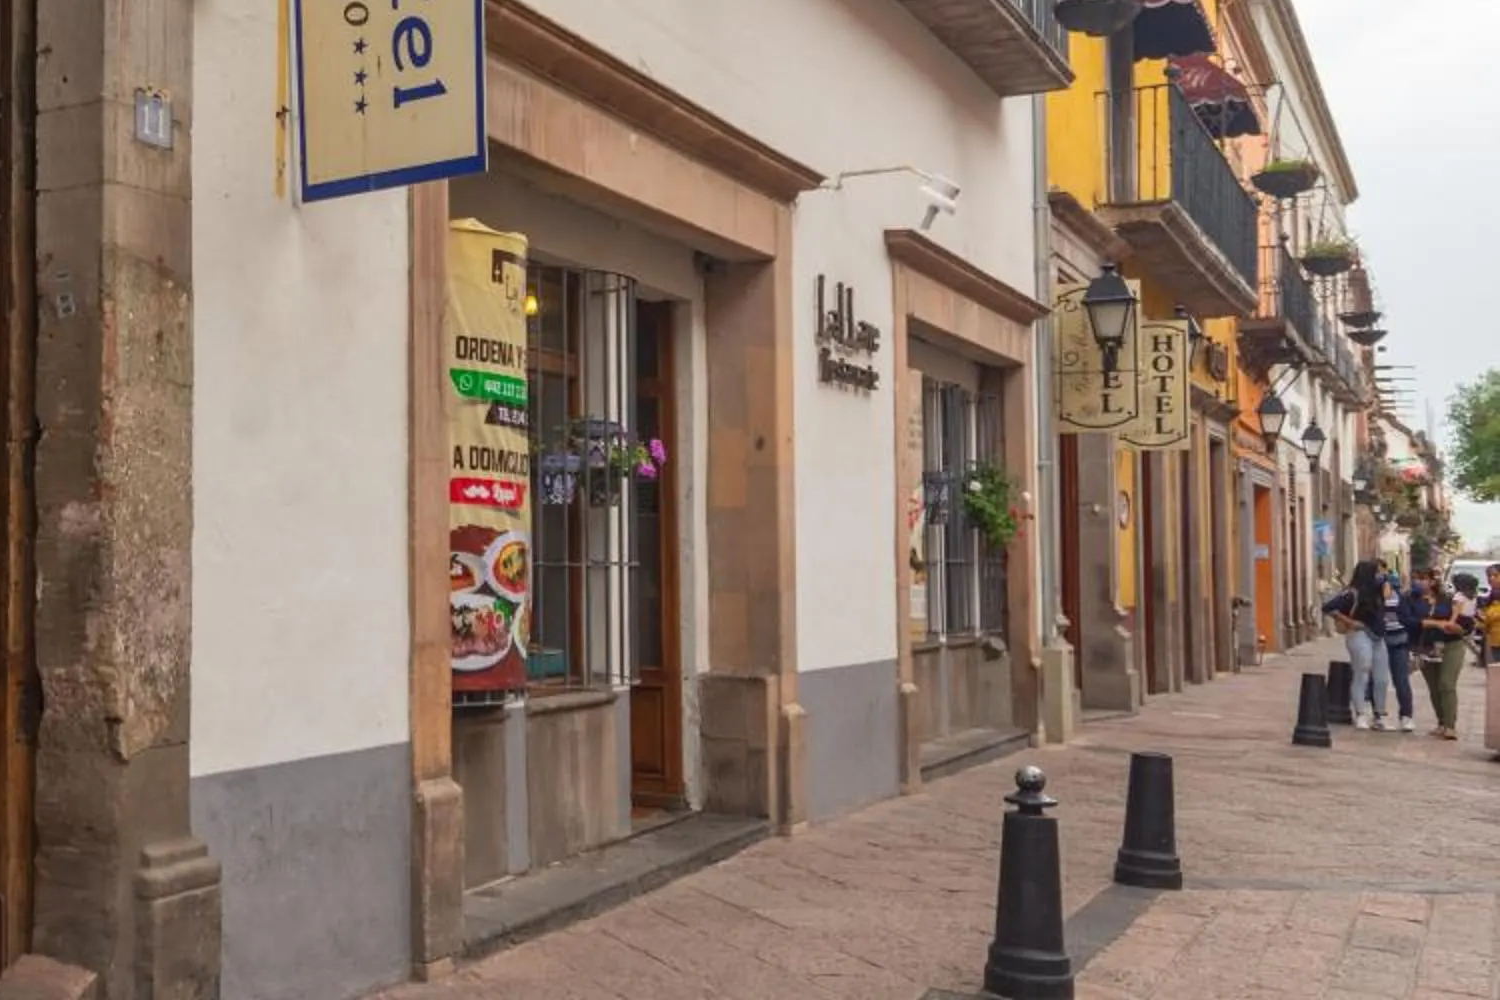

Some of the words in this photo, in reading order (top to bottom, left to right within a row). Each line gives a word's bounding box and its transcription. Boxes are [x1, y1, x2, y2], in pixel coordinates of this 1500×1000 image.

[455, 335, 515, 368] ORDENA
[1151, 335, 1175, 435] HOTEL
[453, 444, 464, 470] A
